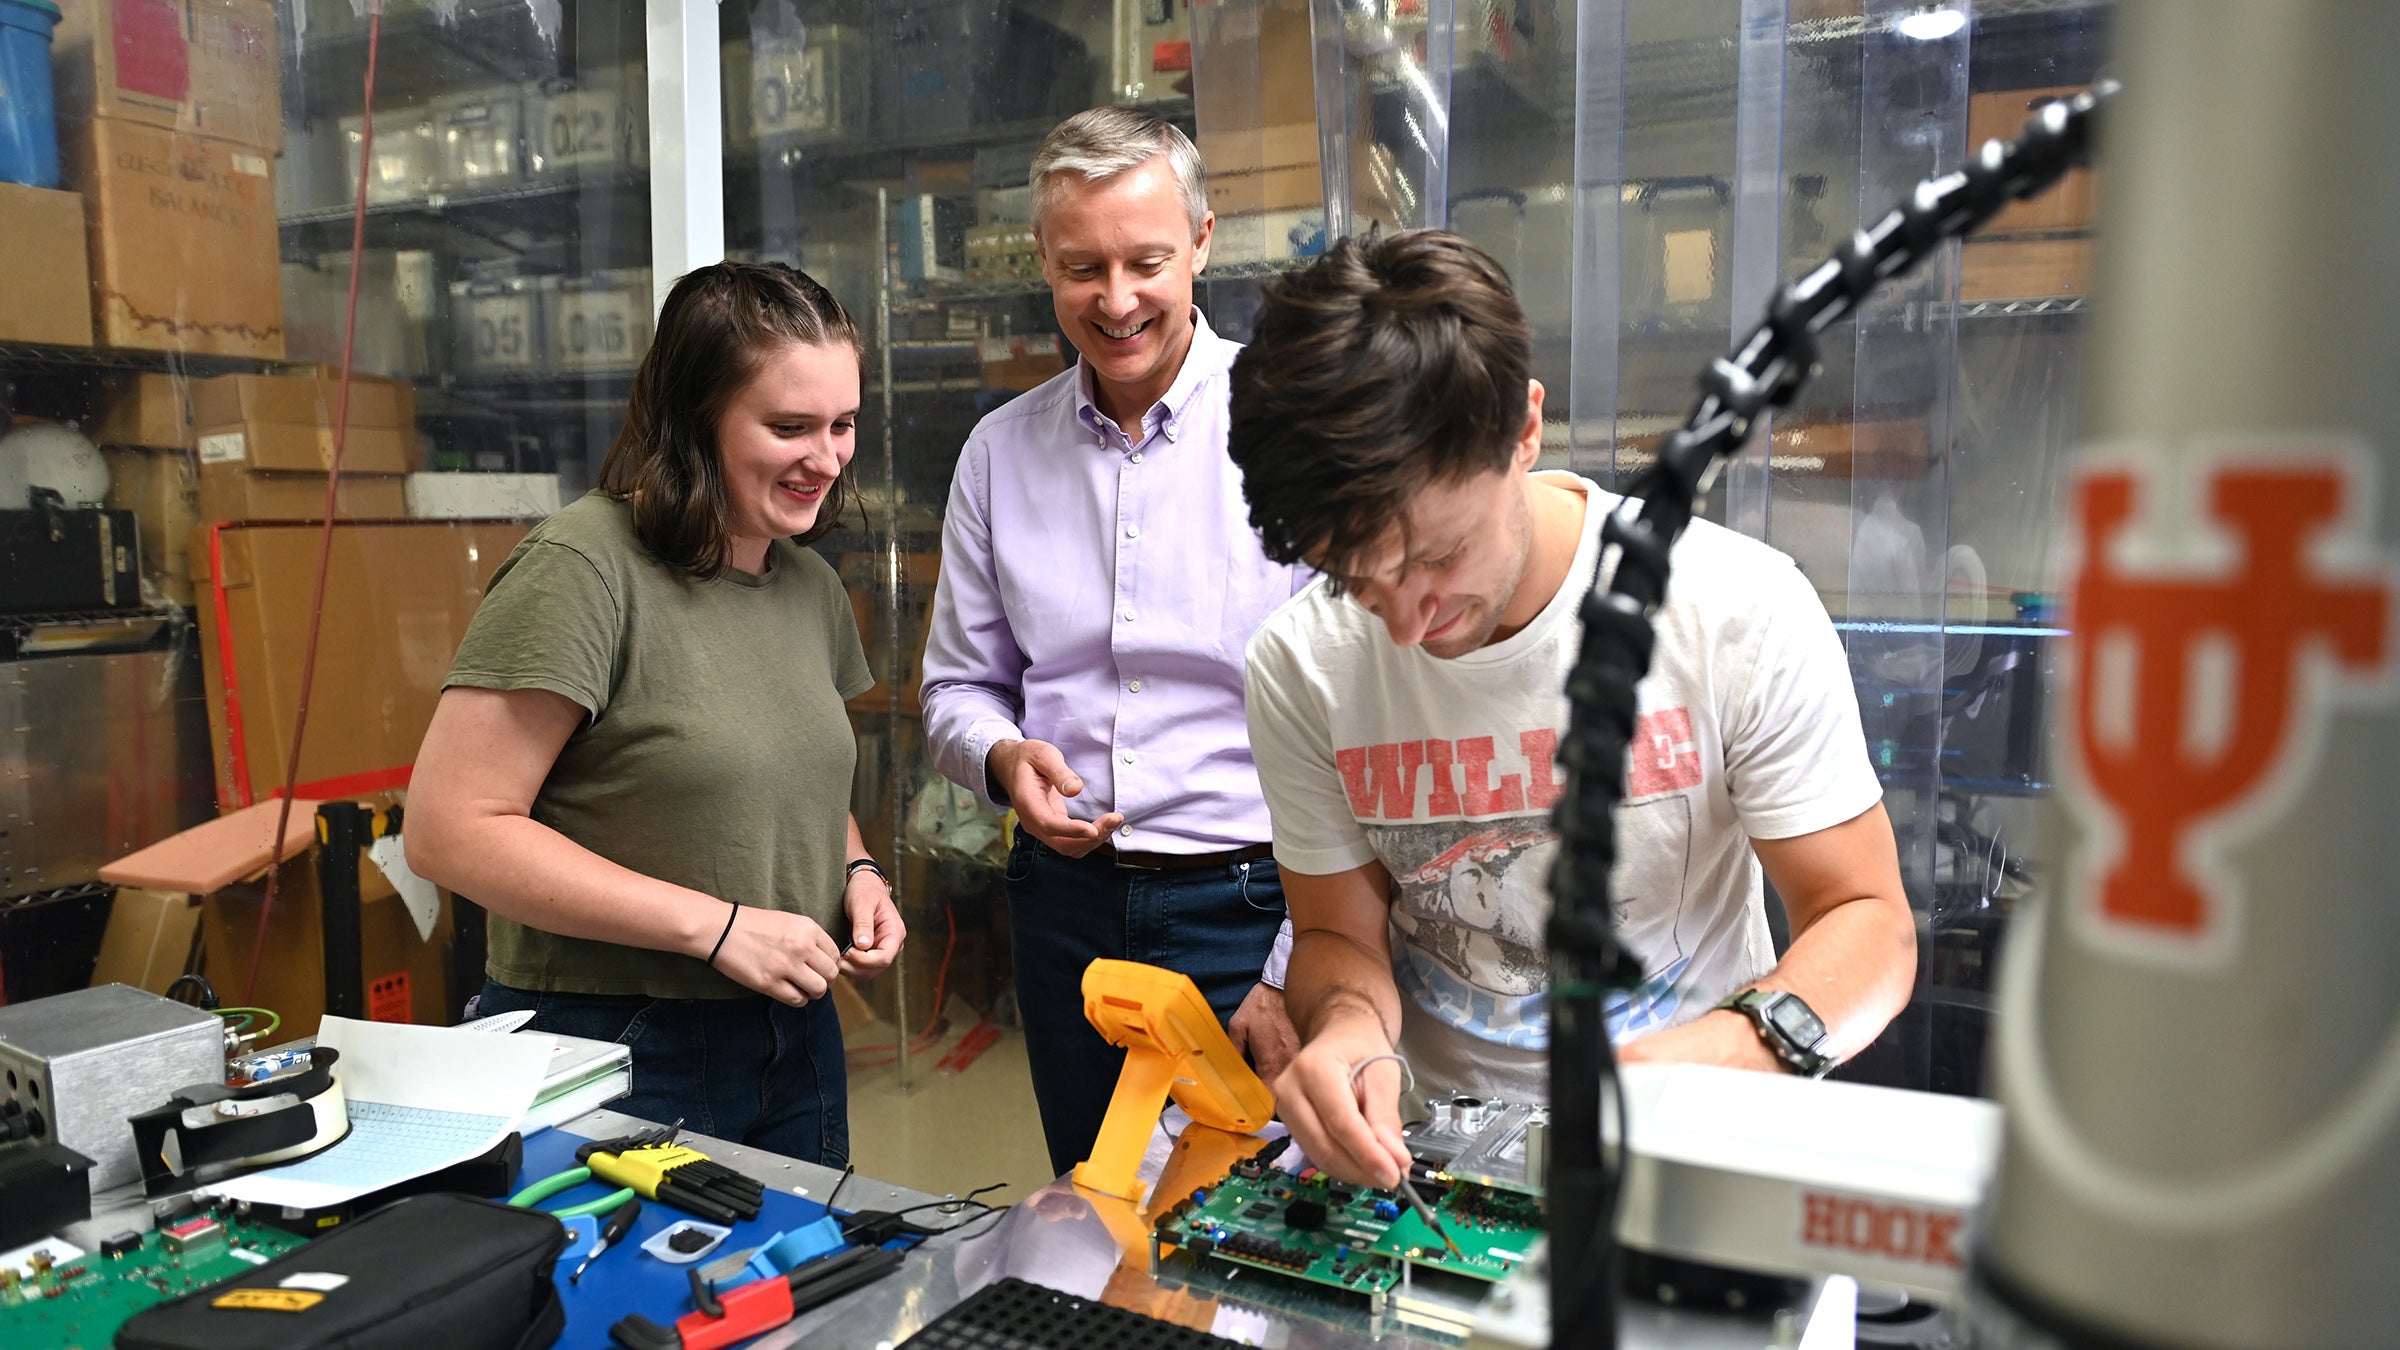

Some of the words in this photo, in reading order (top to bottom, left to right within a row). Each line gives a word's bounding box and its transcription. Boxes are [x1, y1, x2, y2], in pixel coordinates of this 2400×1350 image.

[479, 313, 522, 357] 05
[569, 311, 627, 353] 06
[1336, 707, 1702, 819] WILLE
[1803, 1191, 1966, 1271] HOOK
